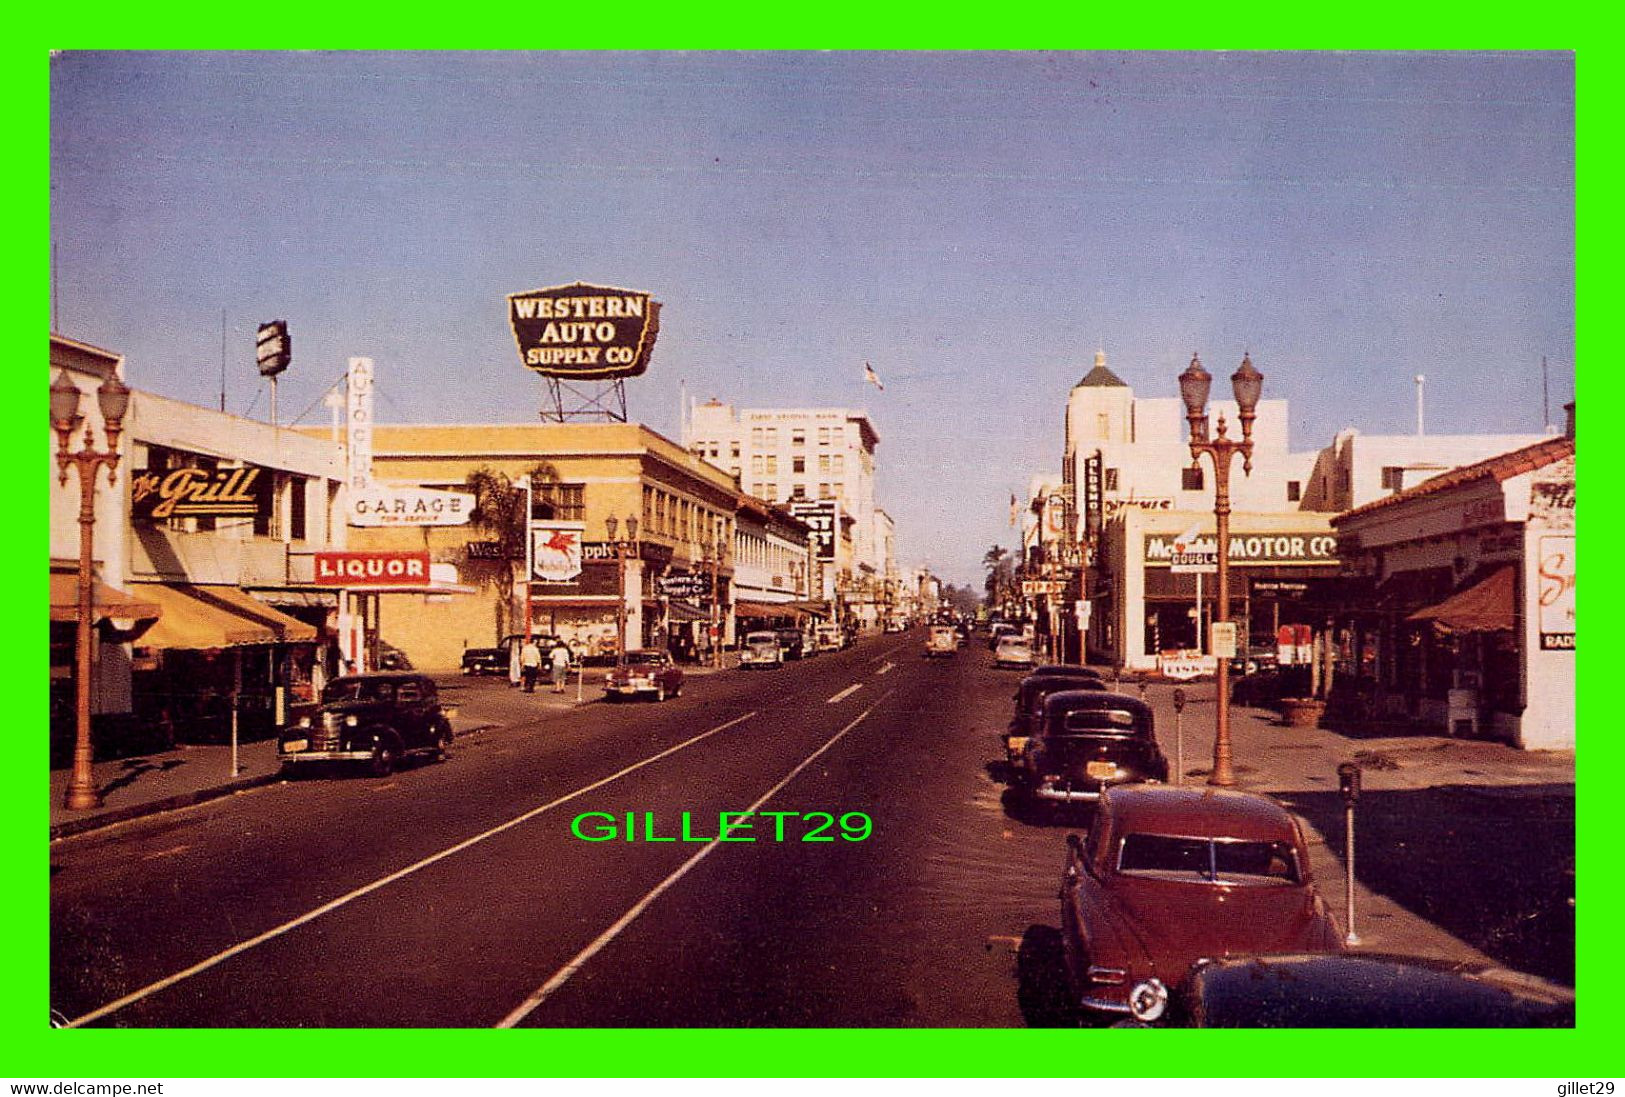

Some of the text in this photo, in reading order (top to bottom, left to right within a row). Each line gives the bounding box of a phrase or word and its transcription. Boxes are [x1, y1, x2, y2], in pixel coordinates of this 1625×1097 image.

[513, 296, 643, 318] WESTERN
[539, 321, 615, 343] AUTO
[527, 346, 634, 364] SUPPLY CO
[353, 363, 367, 421] AUTO
[151, 468, 260, 517] Grill
[356, 499, 461, 513] GARAGE
[1228, 537, 1304, 557] MOTOR
[320, 559, 423, 577] LIQUOR
